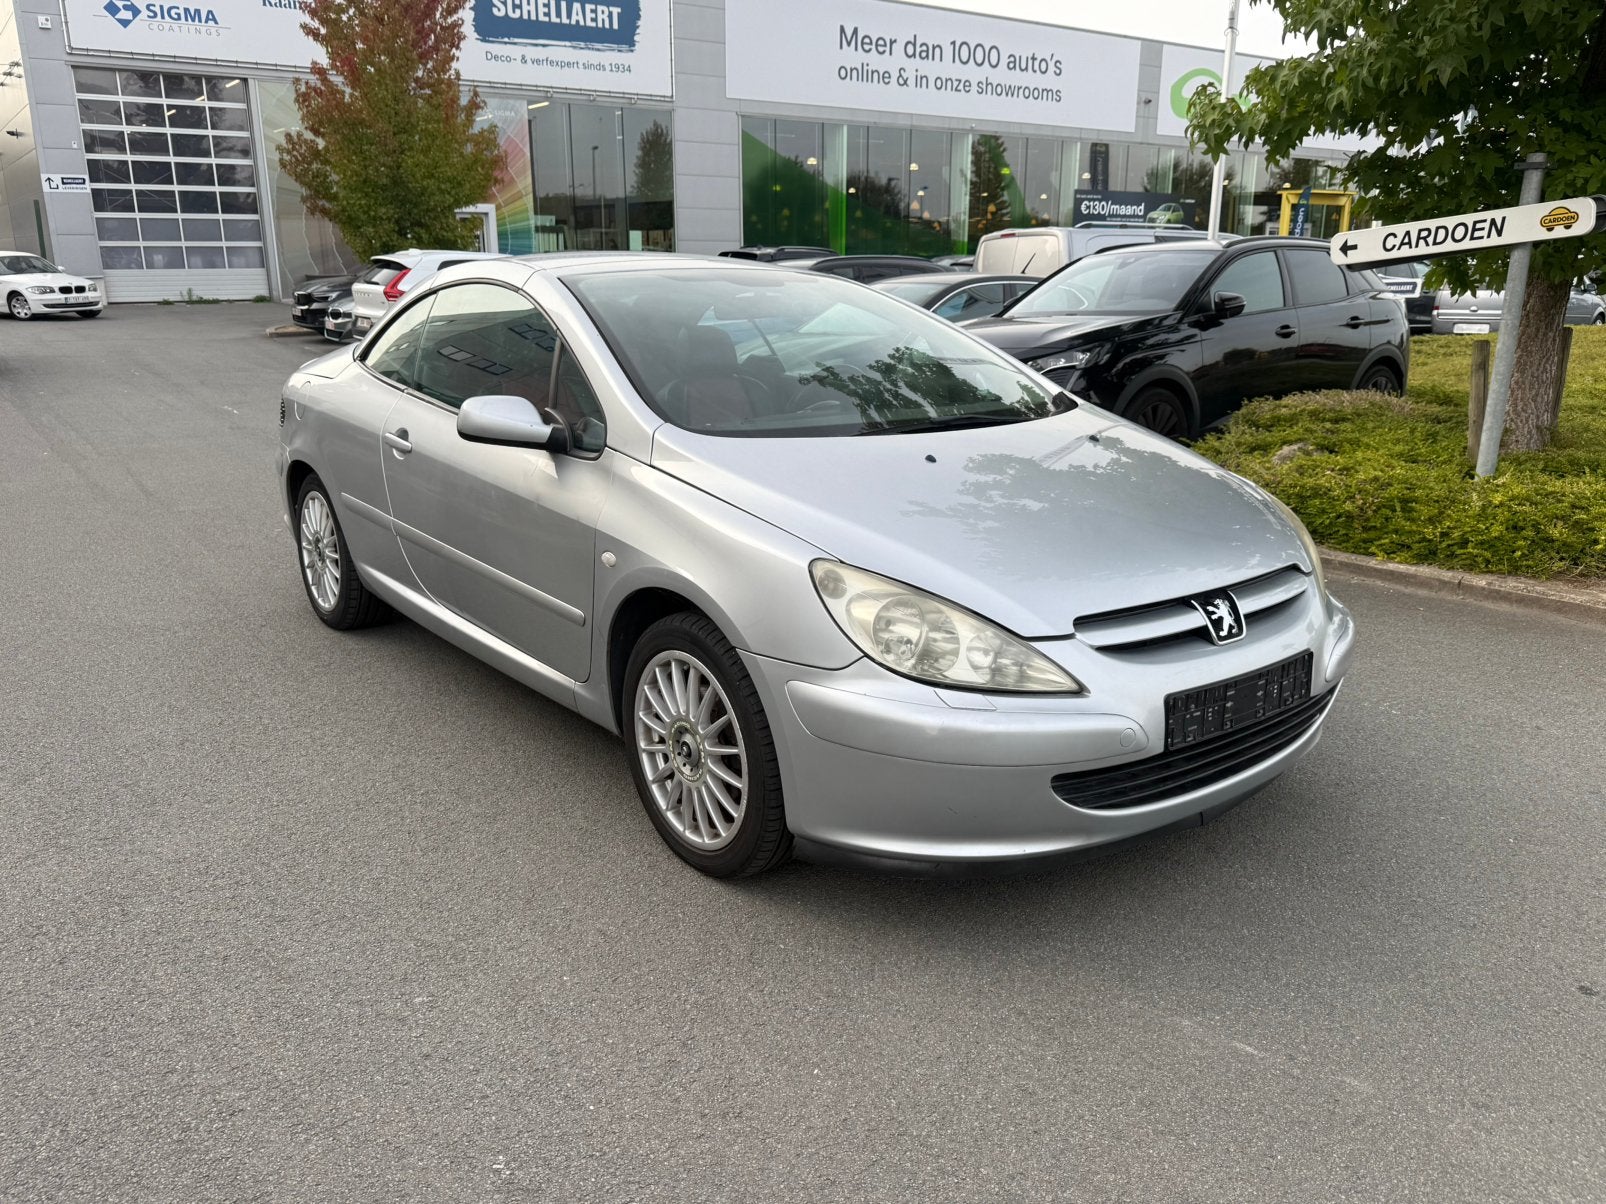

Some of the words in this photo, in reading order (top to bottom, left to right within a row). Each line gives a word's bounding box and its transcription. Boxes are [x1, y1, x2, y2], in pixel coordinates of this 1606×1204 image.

[145, 3, 219, 25] SIGMA
[492, 0, 622, 30] SCHELLAERT
[148, 23, 221, 37] COATINGS
[485, 50, 517, 63] Deco-
[520, 54, 528, 64] &
[530, 56, 580, 70] verfexpert
[582, 60, 606, 72] sinds
[609, 62, 632, 74] 1934
[839, 24, 897, 56] Meer
[903, 34, 943, 62] dan
[950, 40, 1001, 69] 1000
[1006, 52, 1063, 77] auto's
[837, 62, 892, 85] online
[896, 67, 909, 88] &
[915, 68, 929, 89] in
[934, 76, 972, 94] onze
[976, 76, 1062, 103] showrooms
[1081, 200, 1145, 216] €130/maand
[1543, 213, 1576, 225] CARDOEN
[1382, 216, 1507, 253] CARDOEN
